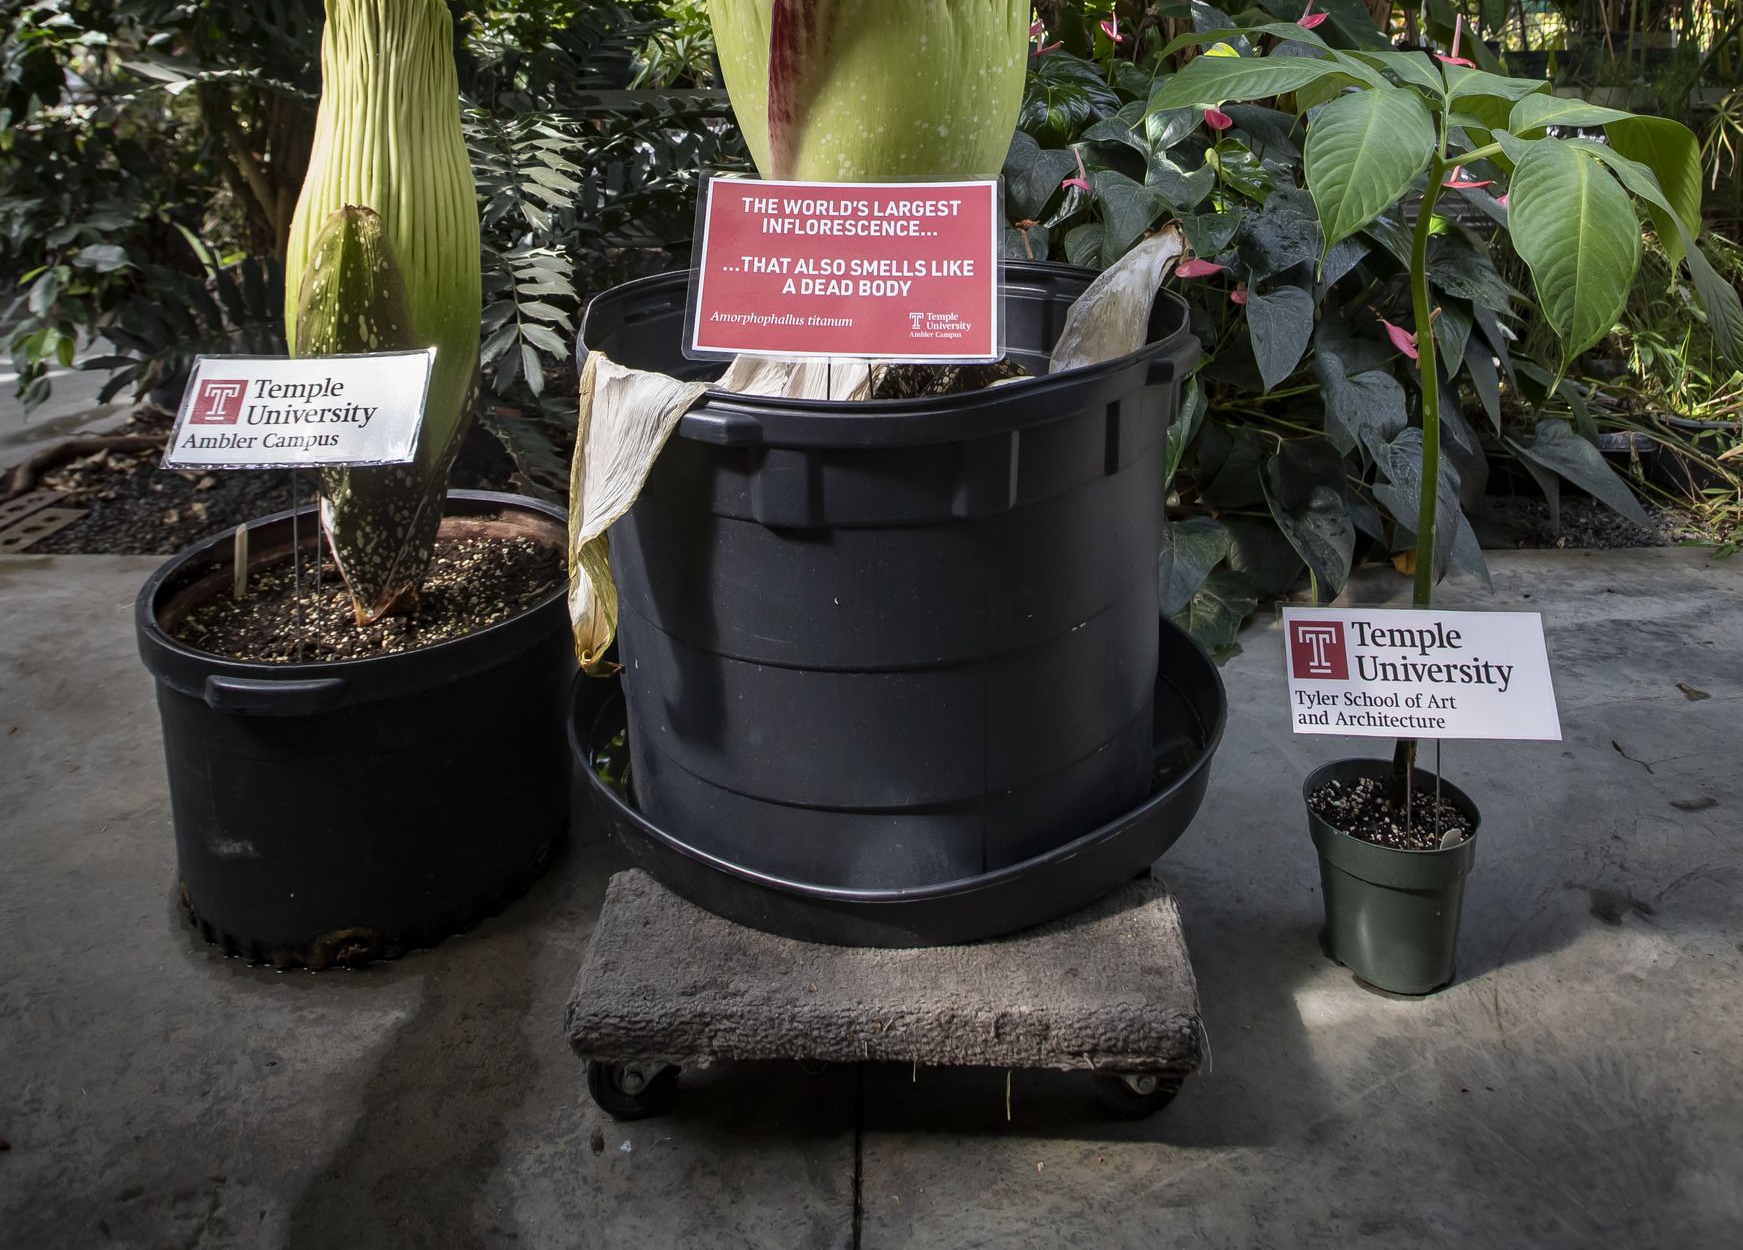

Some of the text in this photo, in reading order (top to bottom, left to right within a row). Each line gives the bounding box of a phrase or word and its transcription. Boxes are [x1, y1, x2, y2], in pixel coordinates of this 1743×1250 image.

[742, 197, 961, 216] THE WORLD'S LARGEST
[762, 218, 938, 236] INFLORESCENCE...
[723, 256, 974, 276] ...THAT ALSO SMELLS LIKE
[782, 279, 912, 297] A DEAD BODY
[710, 311, 853, 327] Amorphophallus titanum
[926, 312, 959, 322] Temple
[926, 321, 971, 332] University
[935, 331, 962, 339] Campus
[254, 377, 344, 403] Temple
[247, 402, 378, 428] University
[181, 433, 339, 451] Ambler Campus
[1351, 621, 1463, 656] Temple
[1355, 655, 1513, 692] University
[1295, 690, 1456, 709] Tyler School of Art
[1298, 711, 1446, 729] and Architecture
